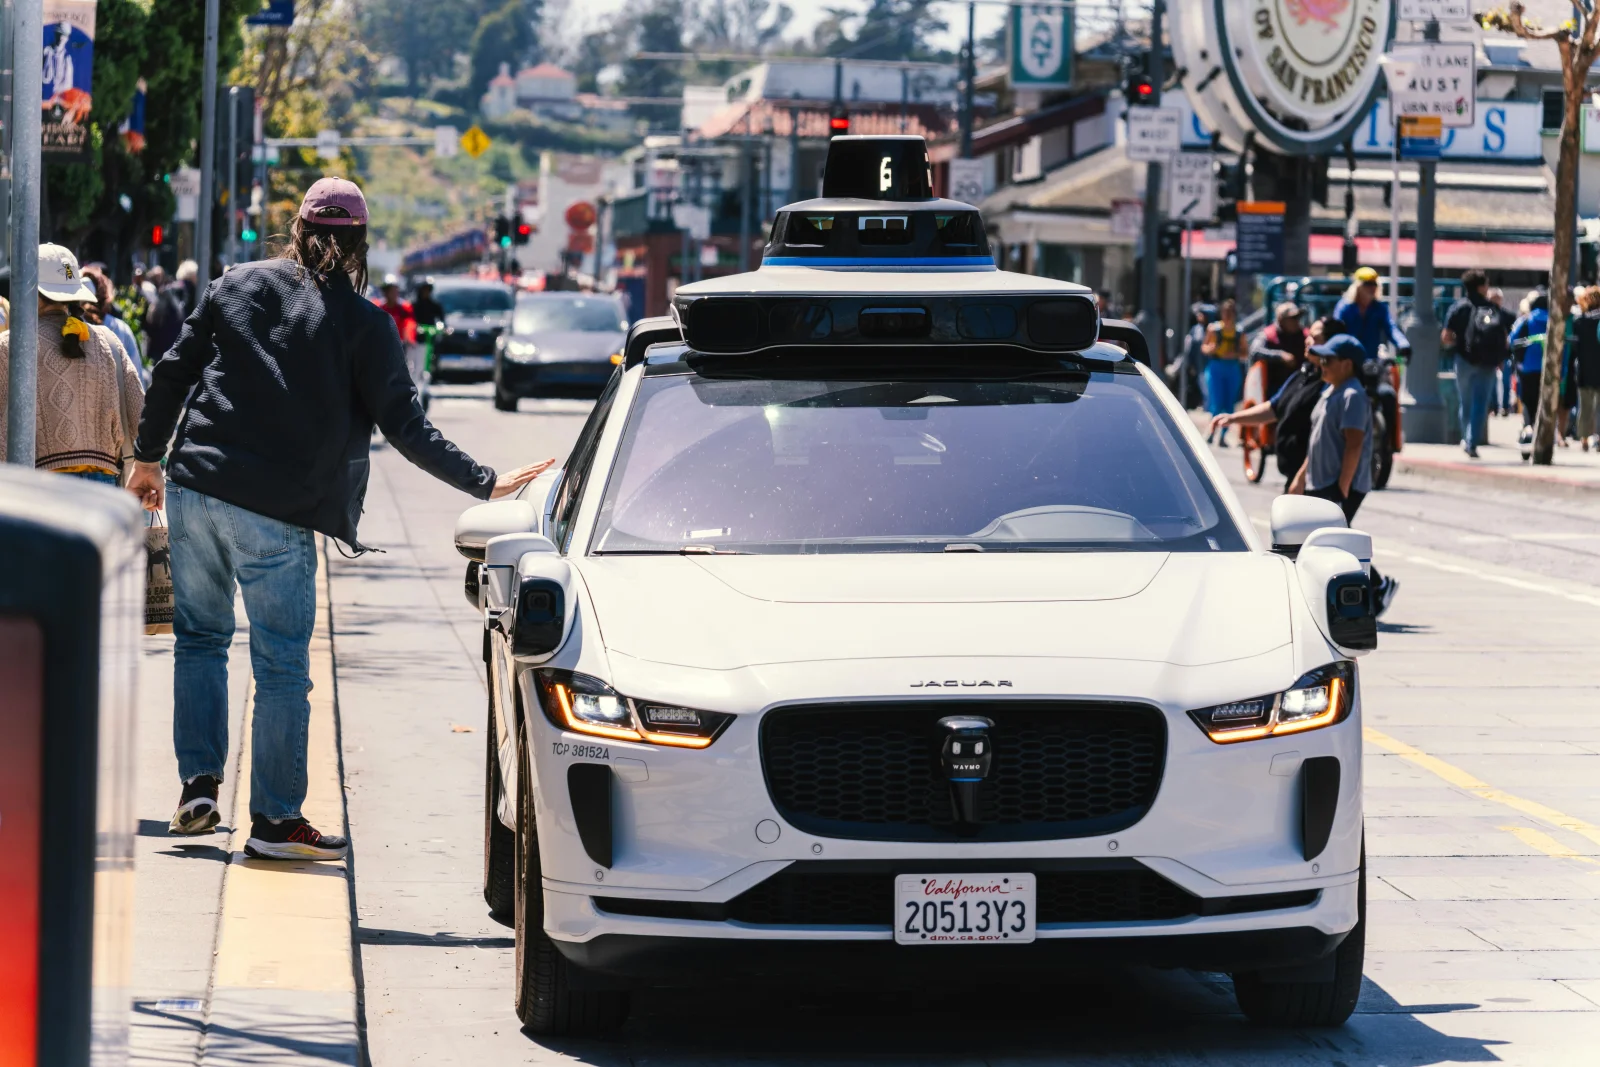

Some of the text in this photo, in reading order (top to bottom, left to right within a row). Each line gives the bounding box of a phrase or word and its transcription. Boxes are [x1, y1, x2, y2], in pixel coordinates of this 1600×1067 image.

[1255, 9, 1377, 104] OF SAN FRANCISCO
[1437, 56, 1469, 68] LANE
[1402, 102, 1428, 113] URN
[154, 587, 174, 595] EARE
[552, 742, 610, 760] TCP 38152A
[924, 879, 1010, 899] California
[905, 900, 1026, 933] 20513Y3
